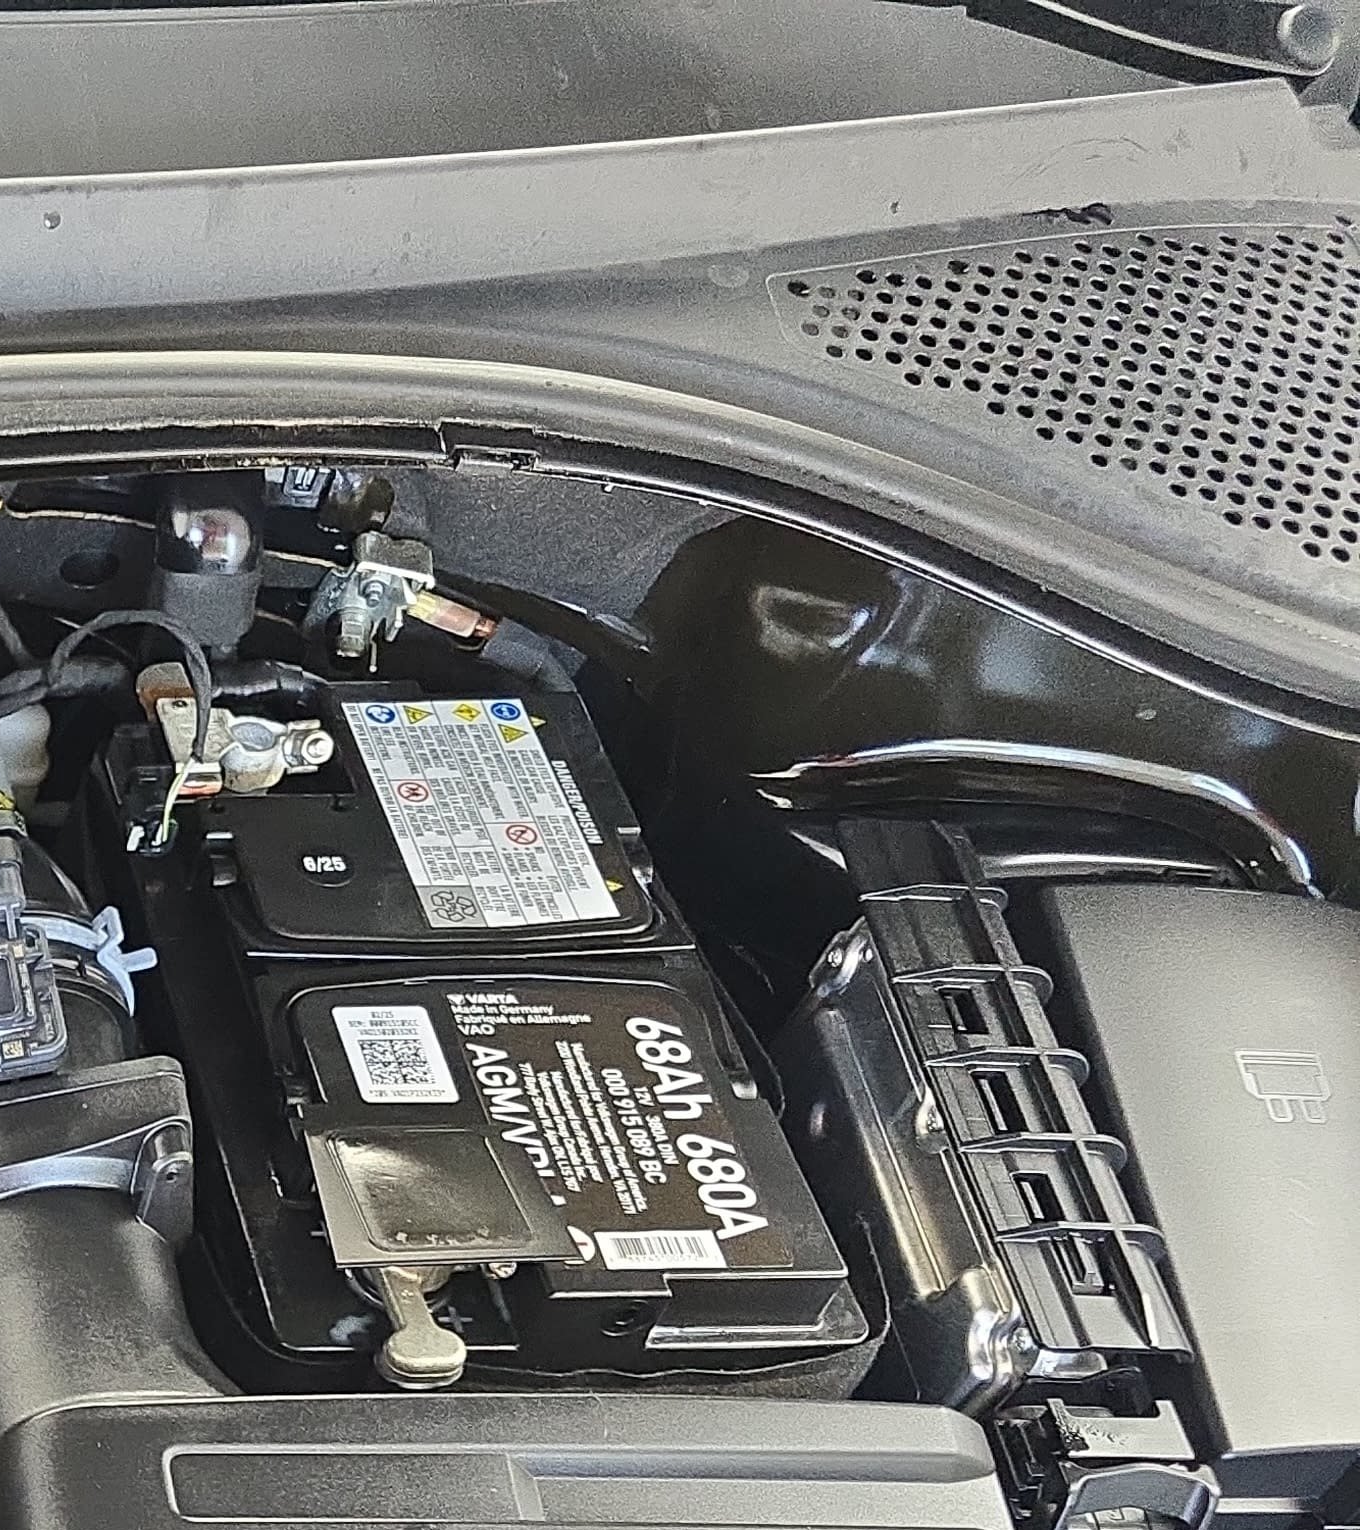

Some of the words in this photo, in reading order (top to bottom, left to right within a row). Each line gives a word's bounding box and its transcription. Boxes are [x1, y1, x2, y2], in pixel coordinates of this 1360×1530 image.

[552, 761, 602, 843] DANGER/POISON
[303, 856, 346, 872] 6/25
[451, 1005, 483, 1015] Made
[486, 1005, 498, 1015] in
[500, 1005, 554, 1016] Germany
[466, 993, 519, 1005] VARTA
[455, 1014, 507, 1026] Fabriqué
[509, 1015, 525, 1025] en
[526, 1014, 591, 1026] Allemagne
[459, 1025, 496, 1036] VAO
[519, 1063, 534, 1076] 777
[571, 1043, 599, 1090] Manufactured
[550, 1071, 579, 1119] Manufactured
[602, 1069, 629, 1095] 000
[591, 1092, 602, 1101] for
[530, 1071, 560, 1115] Volkswagen
[554, 1116, 569, 1137] Group
[563, 1138, 581, 1165] Canada
[564, 1059, 586, 1093] Woodland
[613, 1180, 627, 1191] VA
[596, 1102, 620, 1144] Volkswagen
[614, 1099, 643, 1126] 915
[634, 1087, 654, 1106] 12V
[646, 1115, 668, 1141] 380A
[657, 1144, 679, 1164] DIN
[627, 1018, 711, 1118] 68Ah
[678, 1135, 766, 1238] 680A
[627, 1129, 655, 1156] 089
[611, 1146, 630, 1168] Group
[639, 1160, 666, 1183] BC
